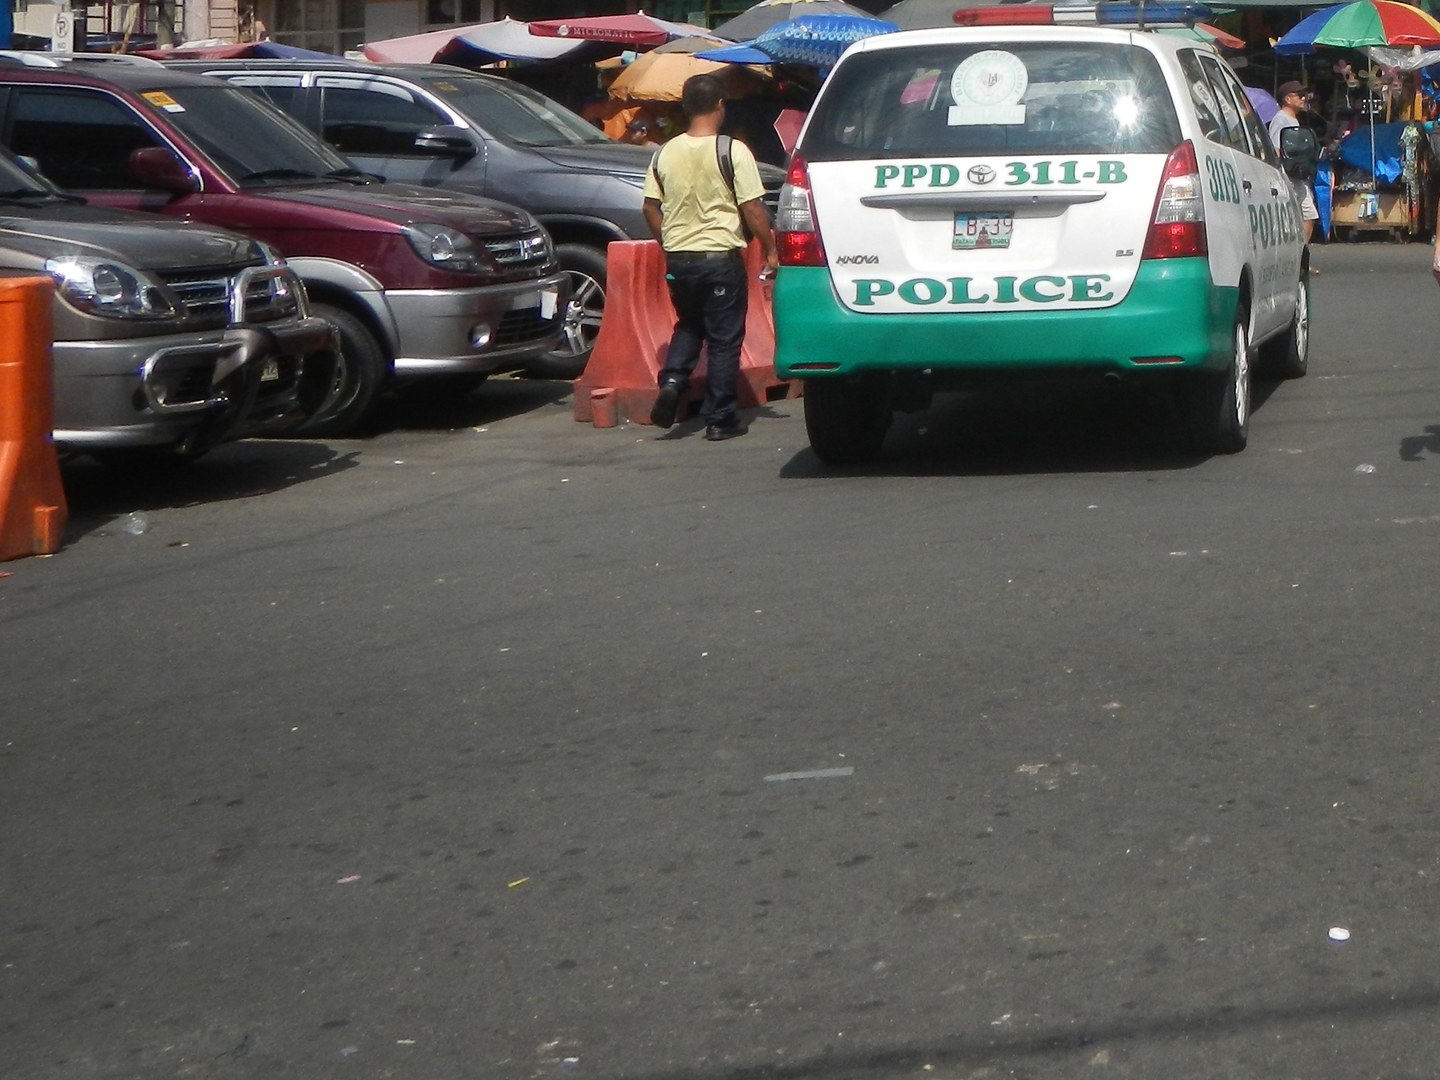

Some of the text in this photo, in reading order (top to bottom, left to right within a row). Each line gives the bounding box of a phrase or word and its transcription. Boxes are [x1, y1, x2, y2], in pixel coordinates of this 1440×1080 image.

[873, 161, 1129, 189] PPD 311-B
[851, 273, 1115, 306] POLICE
